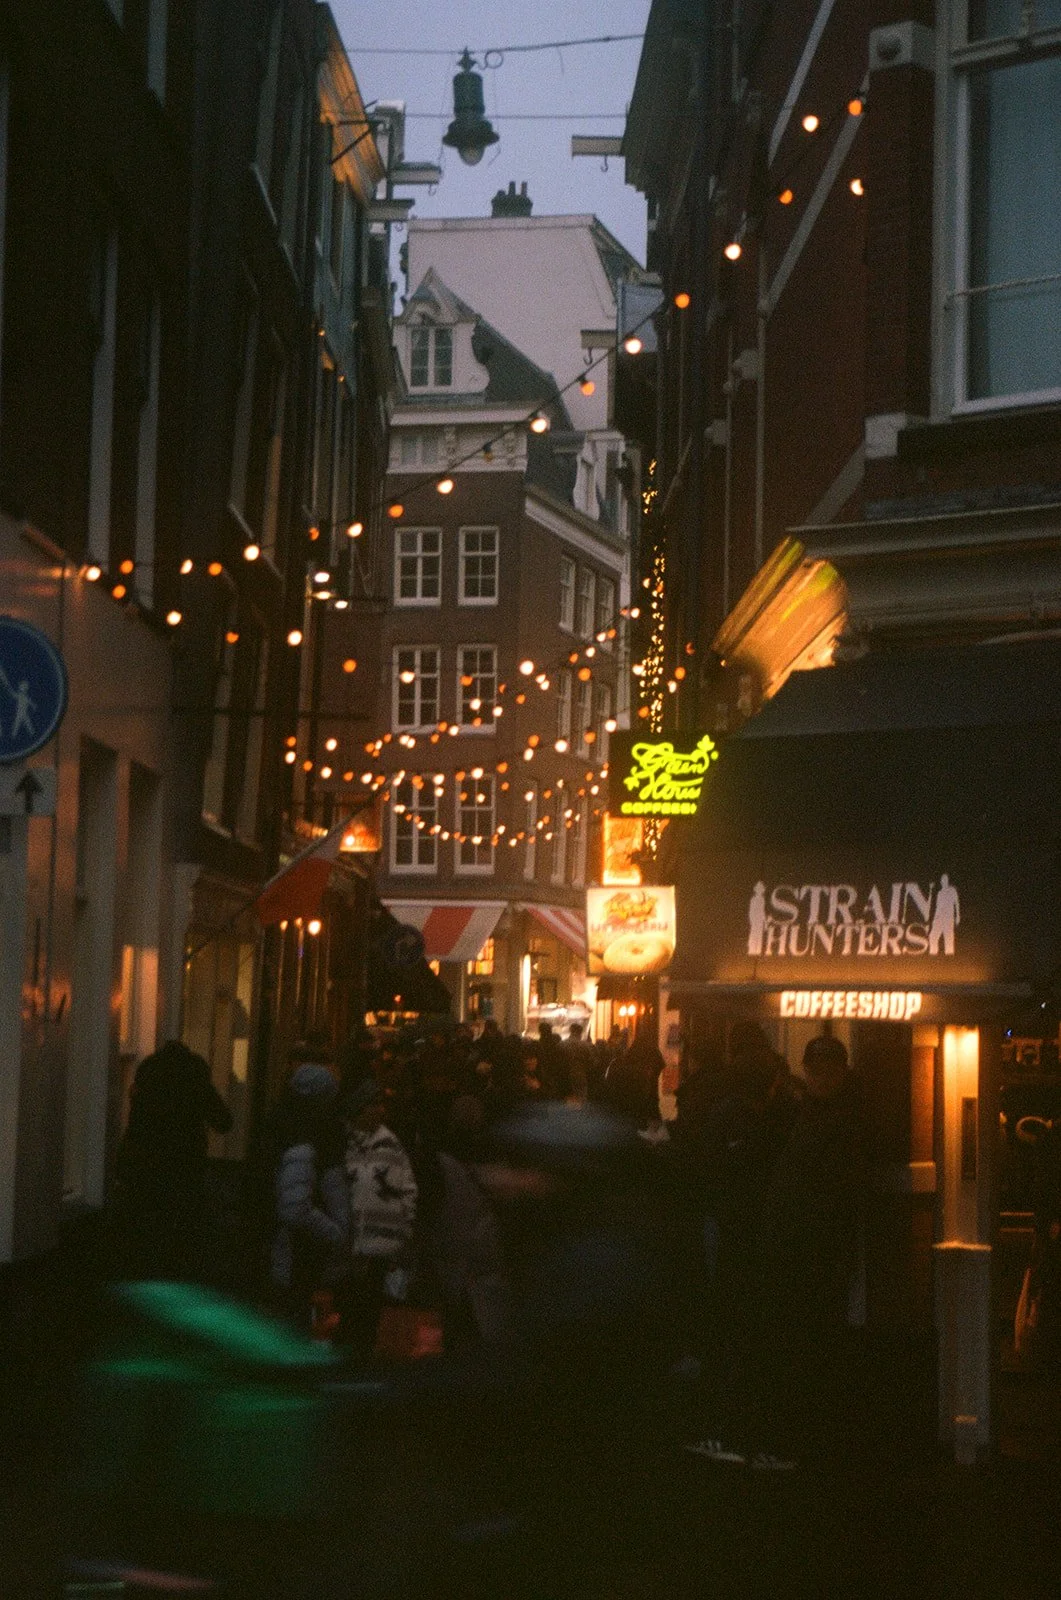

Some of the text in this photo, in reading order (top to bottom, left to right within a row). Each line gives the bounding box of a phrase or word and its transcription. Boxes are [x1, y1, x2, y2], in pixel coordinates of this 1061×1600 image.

[771, 882, 935, 925] STRAIN
[765, 920, 930, 956] HUNTERS
[779, 990, 922, 1021] COFFEESHOP
